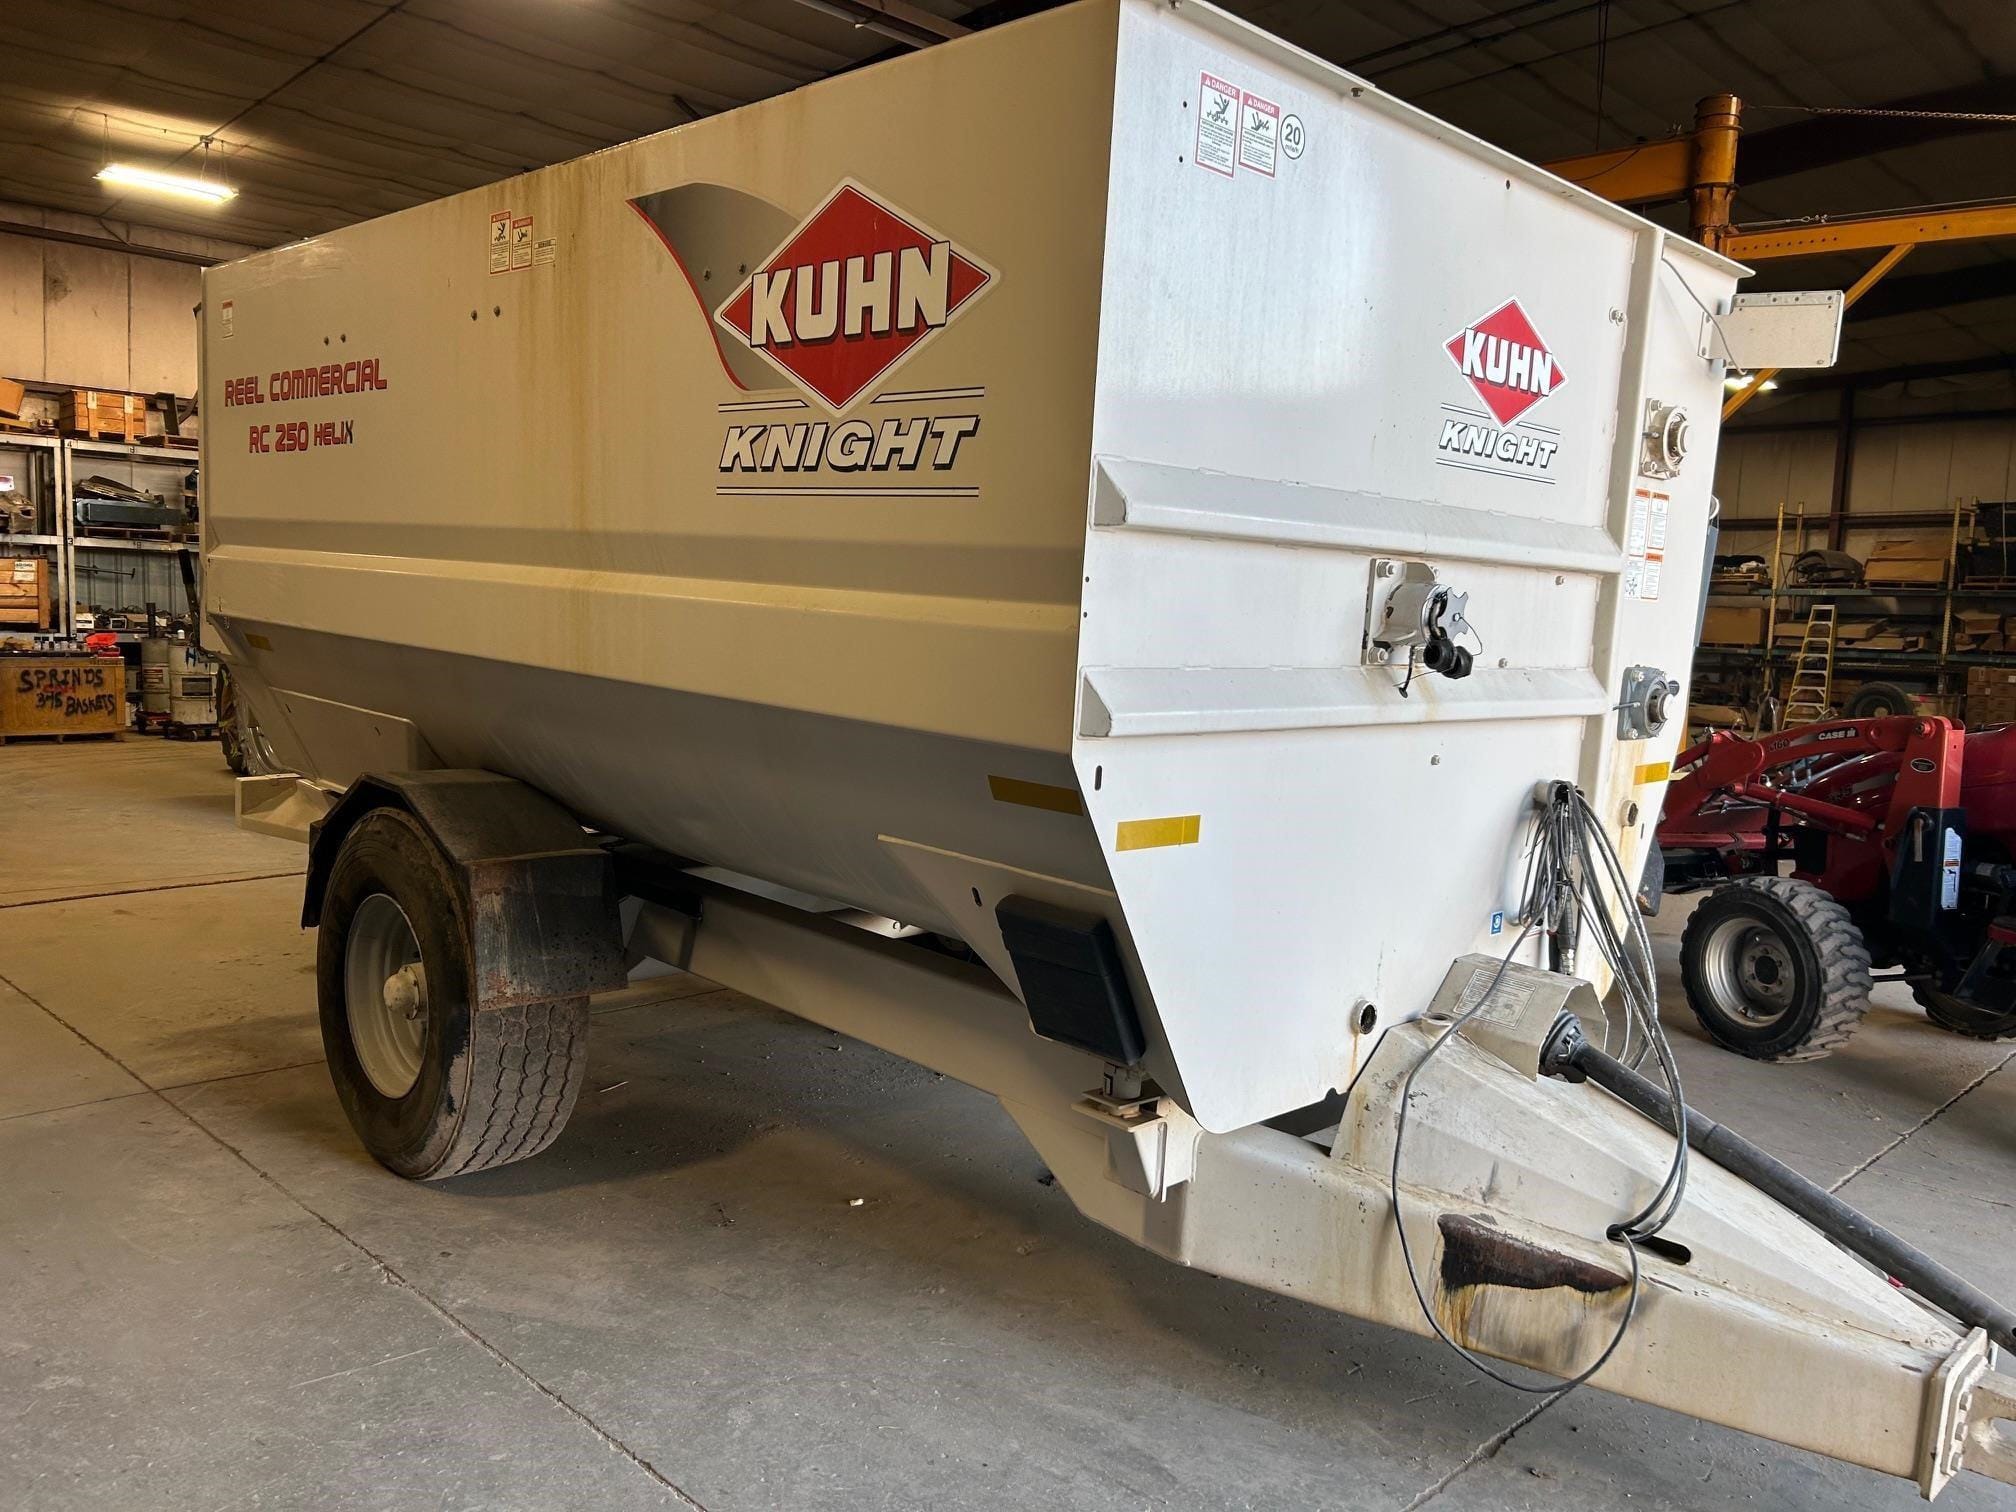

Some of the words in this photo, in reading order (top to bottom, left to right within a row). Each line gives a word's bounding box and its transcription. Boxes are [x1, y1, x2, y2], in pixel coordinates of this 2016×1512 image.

[1211, 79, 1236, 97] DANGER
[1253, 101, 1275, 114] DANGER
[1285, 123, 1301, 146] 20
[750, 241, 951, 347] KUHN
[1462, 328, 1553, 397] KUHN
[224, 376, 265, 407] REEL
[269, 358, 387, 401] COMMERCIAL
[249, 424, 270, 453] RC
[275, 421, 309, 452] 250
[313, 420, 354, 446] HELIX
[719, 415, 981, 473] KNIGHT
[1438, 419, 1558, 469] KNIGHT
[65, 694, 115, 716] BASKETS
[1818, 730, 1845, 741] CASE
